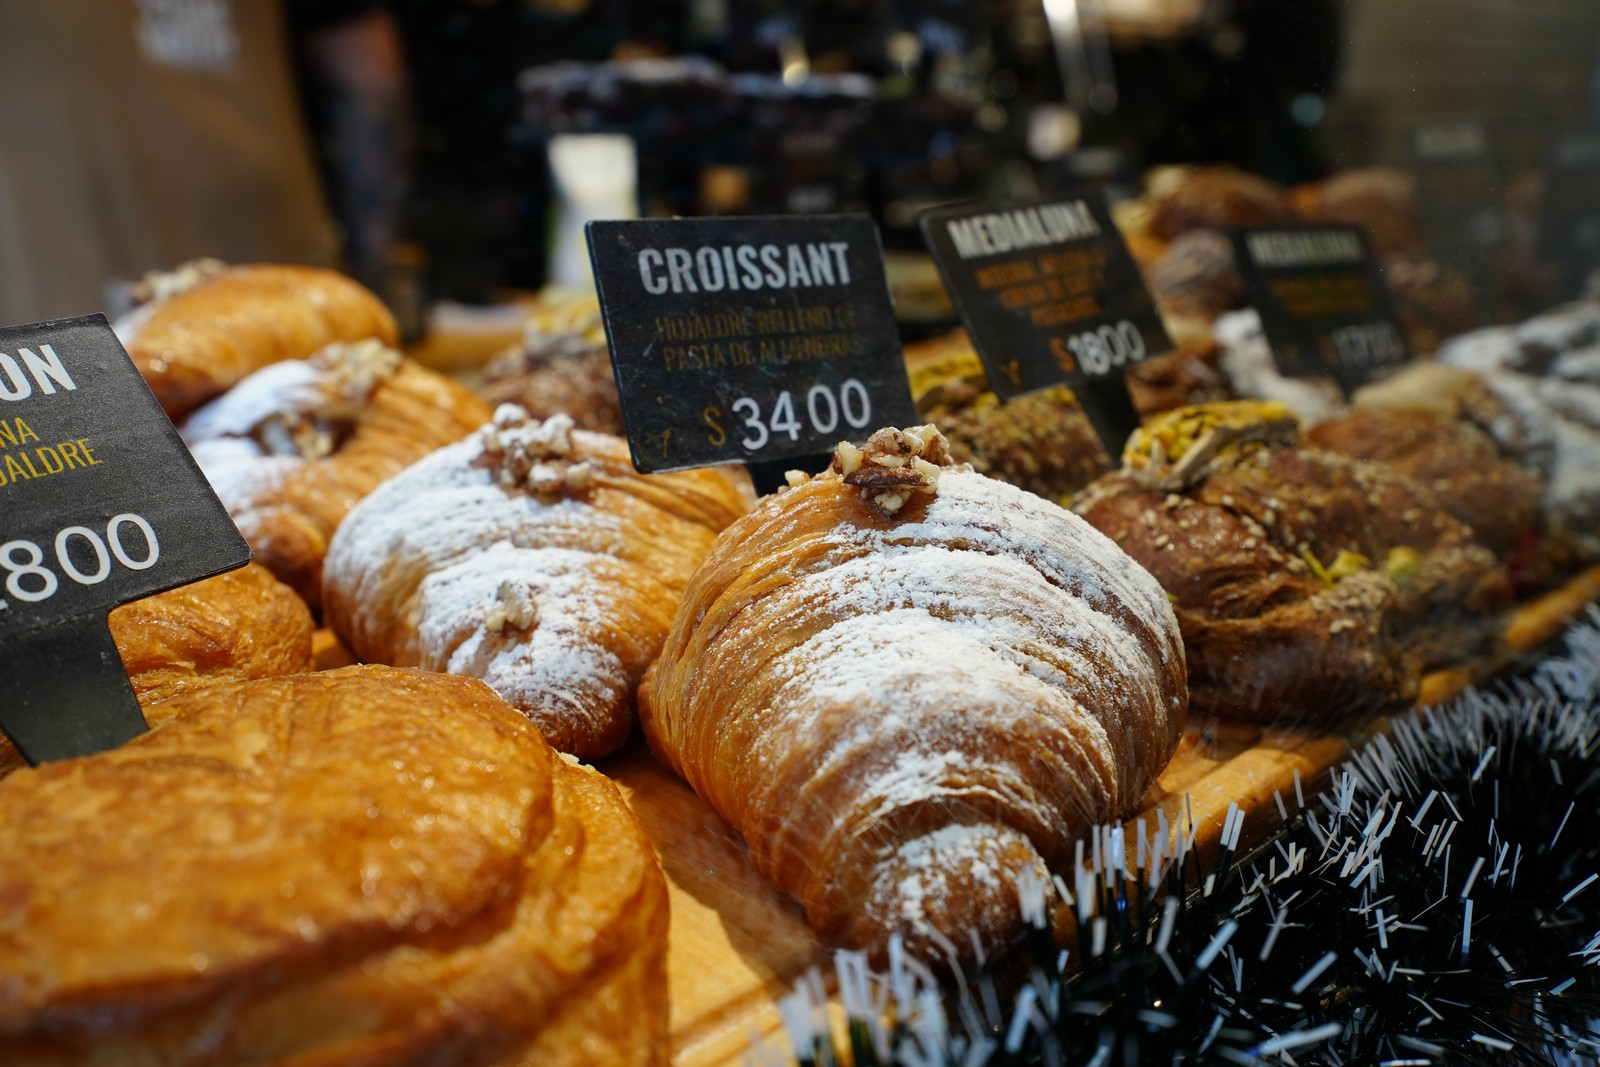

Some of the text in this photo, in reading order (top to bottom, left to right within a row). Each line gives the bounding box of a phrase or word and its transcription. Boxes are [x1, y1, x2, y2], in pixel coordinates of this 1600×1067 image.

[638, 242, 853, 295] CROISSANT
[655, 311, 753, 342] HOJALDRE
[1067, 319, 1147, 376] 1800
[661, 342, 726, 373] PASTA
[729, 340, 755, 368] DE
[731, 378, 871, 450] 3400
[0, 513, 160, 611] 800
